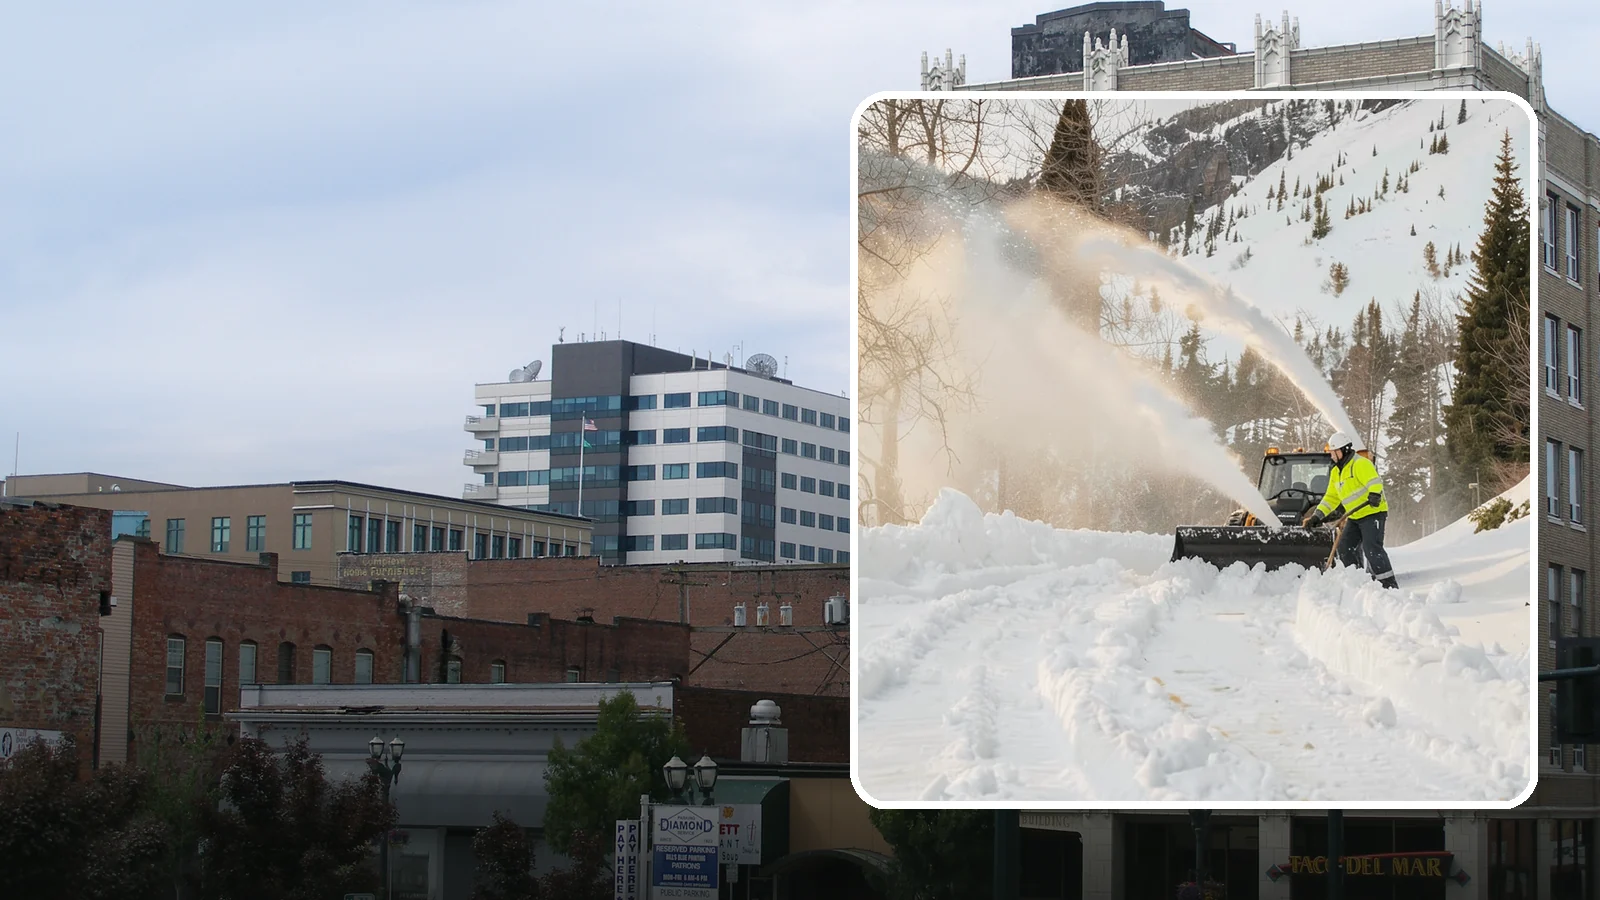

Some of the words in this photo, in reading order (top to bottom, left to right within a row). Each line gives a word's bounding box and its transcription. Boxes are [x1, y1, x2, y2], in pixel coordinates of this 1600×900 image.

[370, 566, 427, 577] Furnishers
[660, 818, 713, 833] DIAMOND
[1022, 815, 1070, 828] BUILDING
[628, 825, 636, 852] PAY
[656, 845, 688, 853] RESERVED
[689, 846, 716, 854] PARKING
[721, 851, 739, 862] Soup
[671, 862, 701, 870] PATRONS
[1346, 857, 1385, 875] DEL
[1392, 857, 1442, 877] MAR
[617, 856, 625, 893] HERE
[628, 856, 636, 893] HERE
[660, 889, 682, 897] PUBLIC
[683, 890, 710, 898] PARKING
